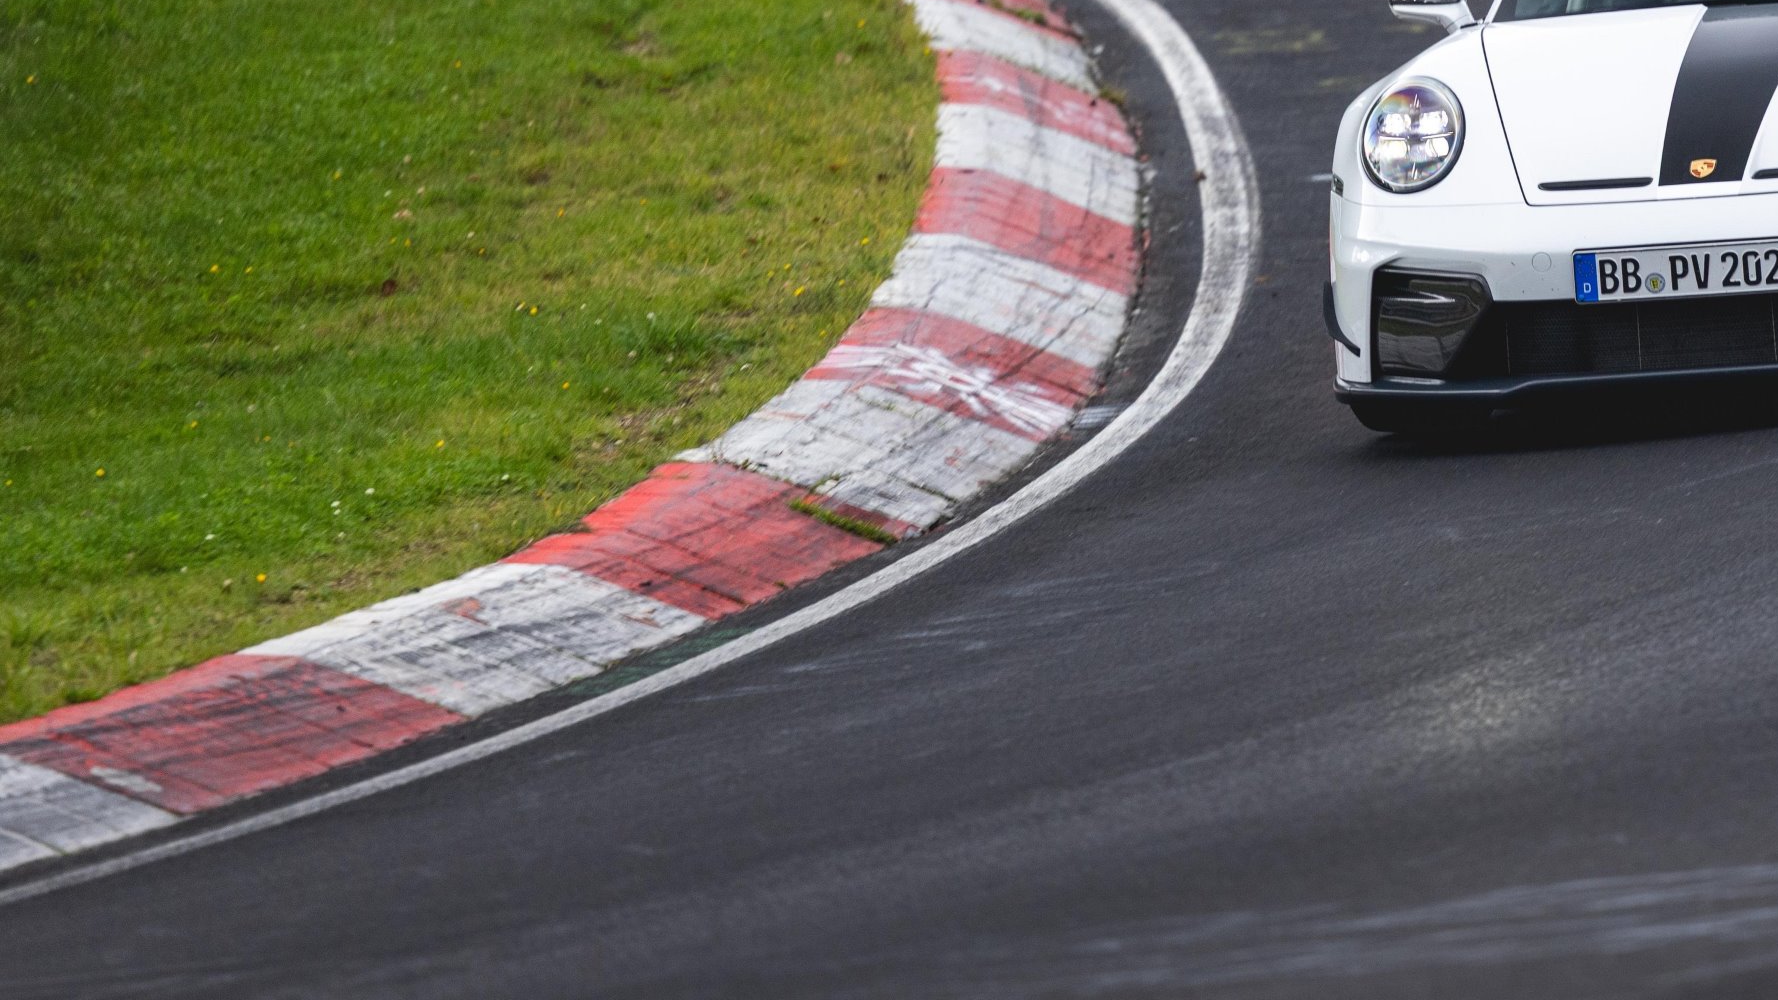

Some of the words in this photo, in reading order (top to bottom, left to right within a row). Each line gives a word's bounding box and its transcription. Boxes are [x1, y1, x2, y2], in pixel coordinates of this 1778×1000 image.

[1599, 258, 1642, 295] BB
[1669, 253, 1710, 291] PV
[1583, 283, 1591, 293] D
